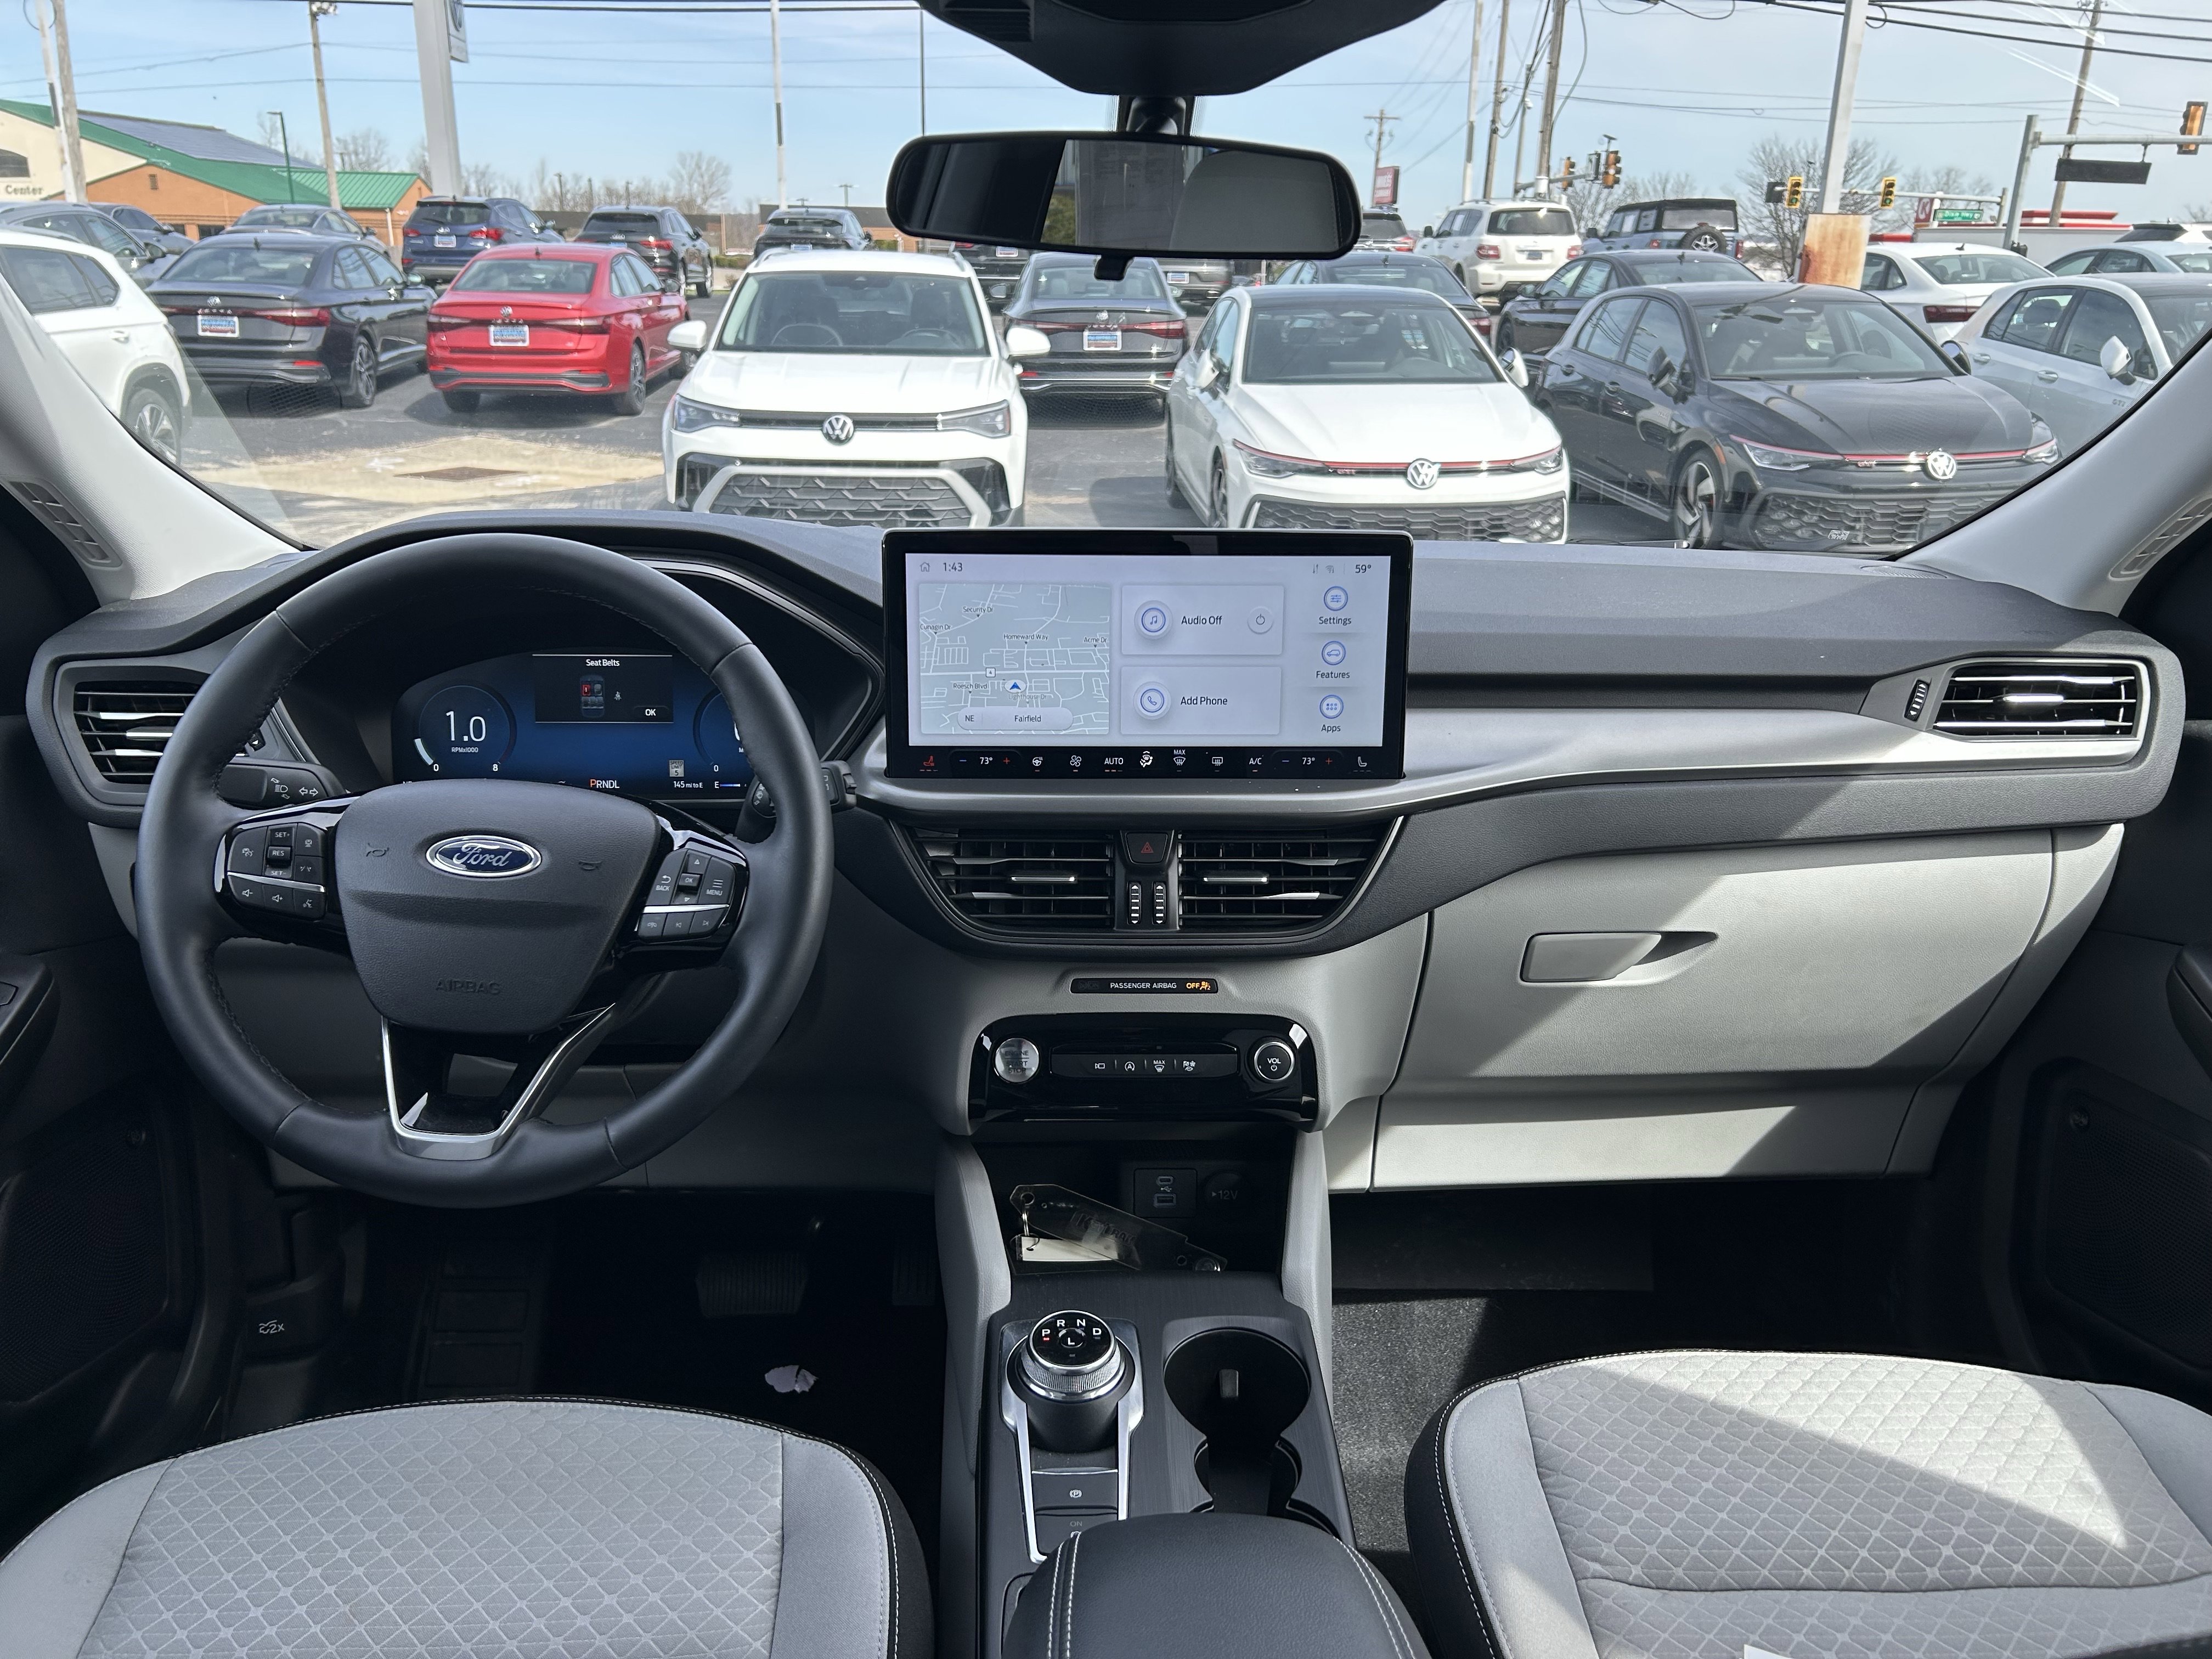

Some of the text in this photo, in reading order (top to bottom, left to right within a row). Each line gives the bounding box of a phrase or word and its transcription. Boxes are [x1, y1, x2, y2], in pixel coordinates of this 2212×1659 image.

[5, 185, 43, 195] Center
[943, 562, 963, 572] 1:43
[1181, 616, 1223, 625] Audio Off
[1318, 616, 1352, 626] Settings
[1316, 670, 1350, 679] Features
[1181, 696, 1228, 705] Add Phone
[445, 710, 486, 742] 1.0
[1321, 724, 1341, 733] Apps
[1249, 757, 1262, 765] A/C
[453, 843, 512, 867] Ford
[436, 979, 500, 995] AIRBAG
[1218, 1189, 1238, 1200] 12V
